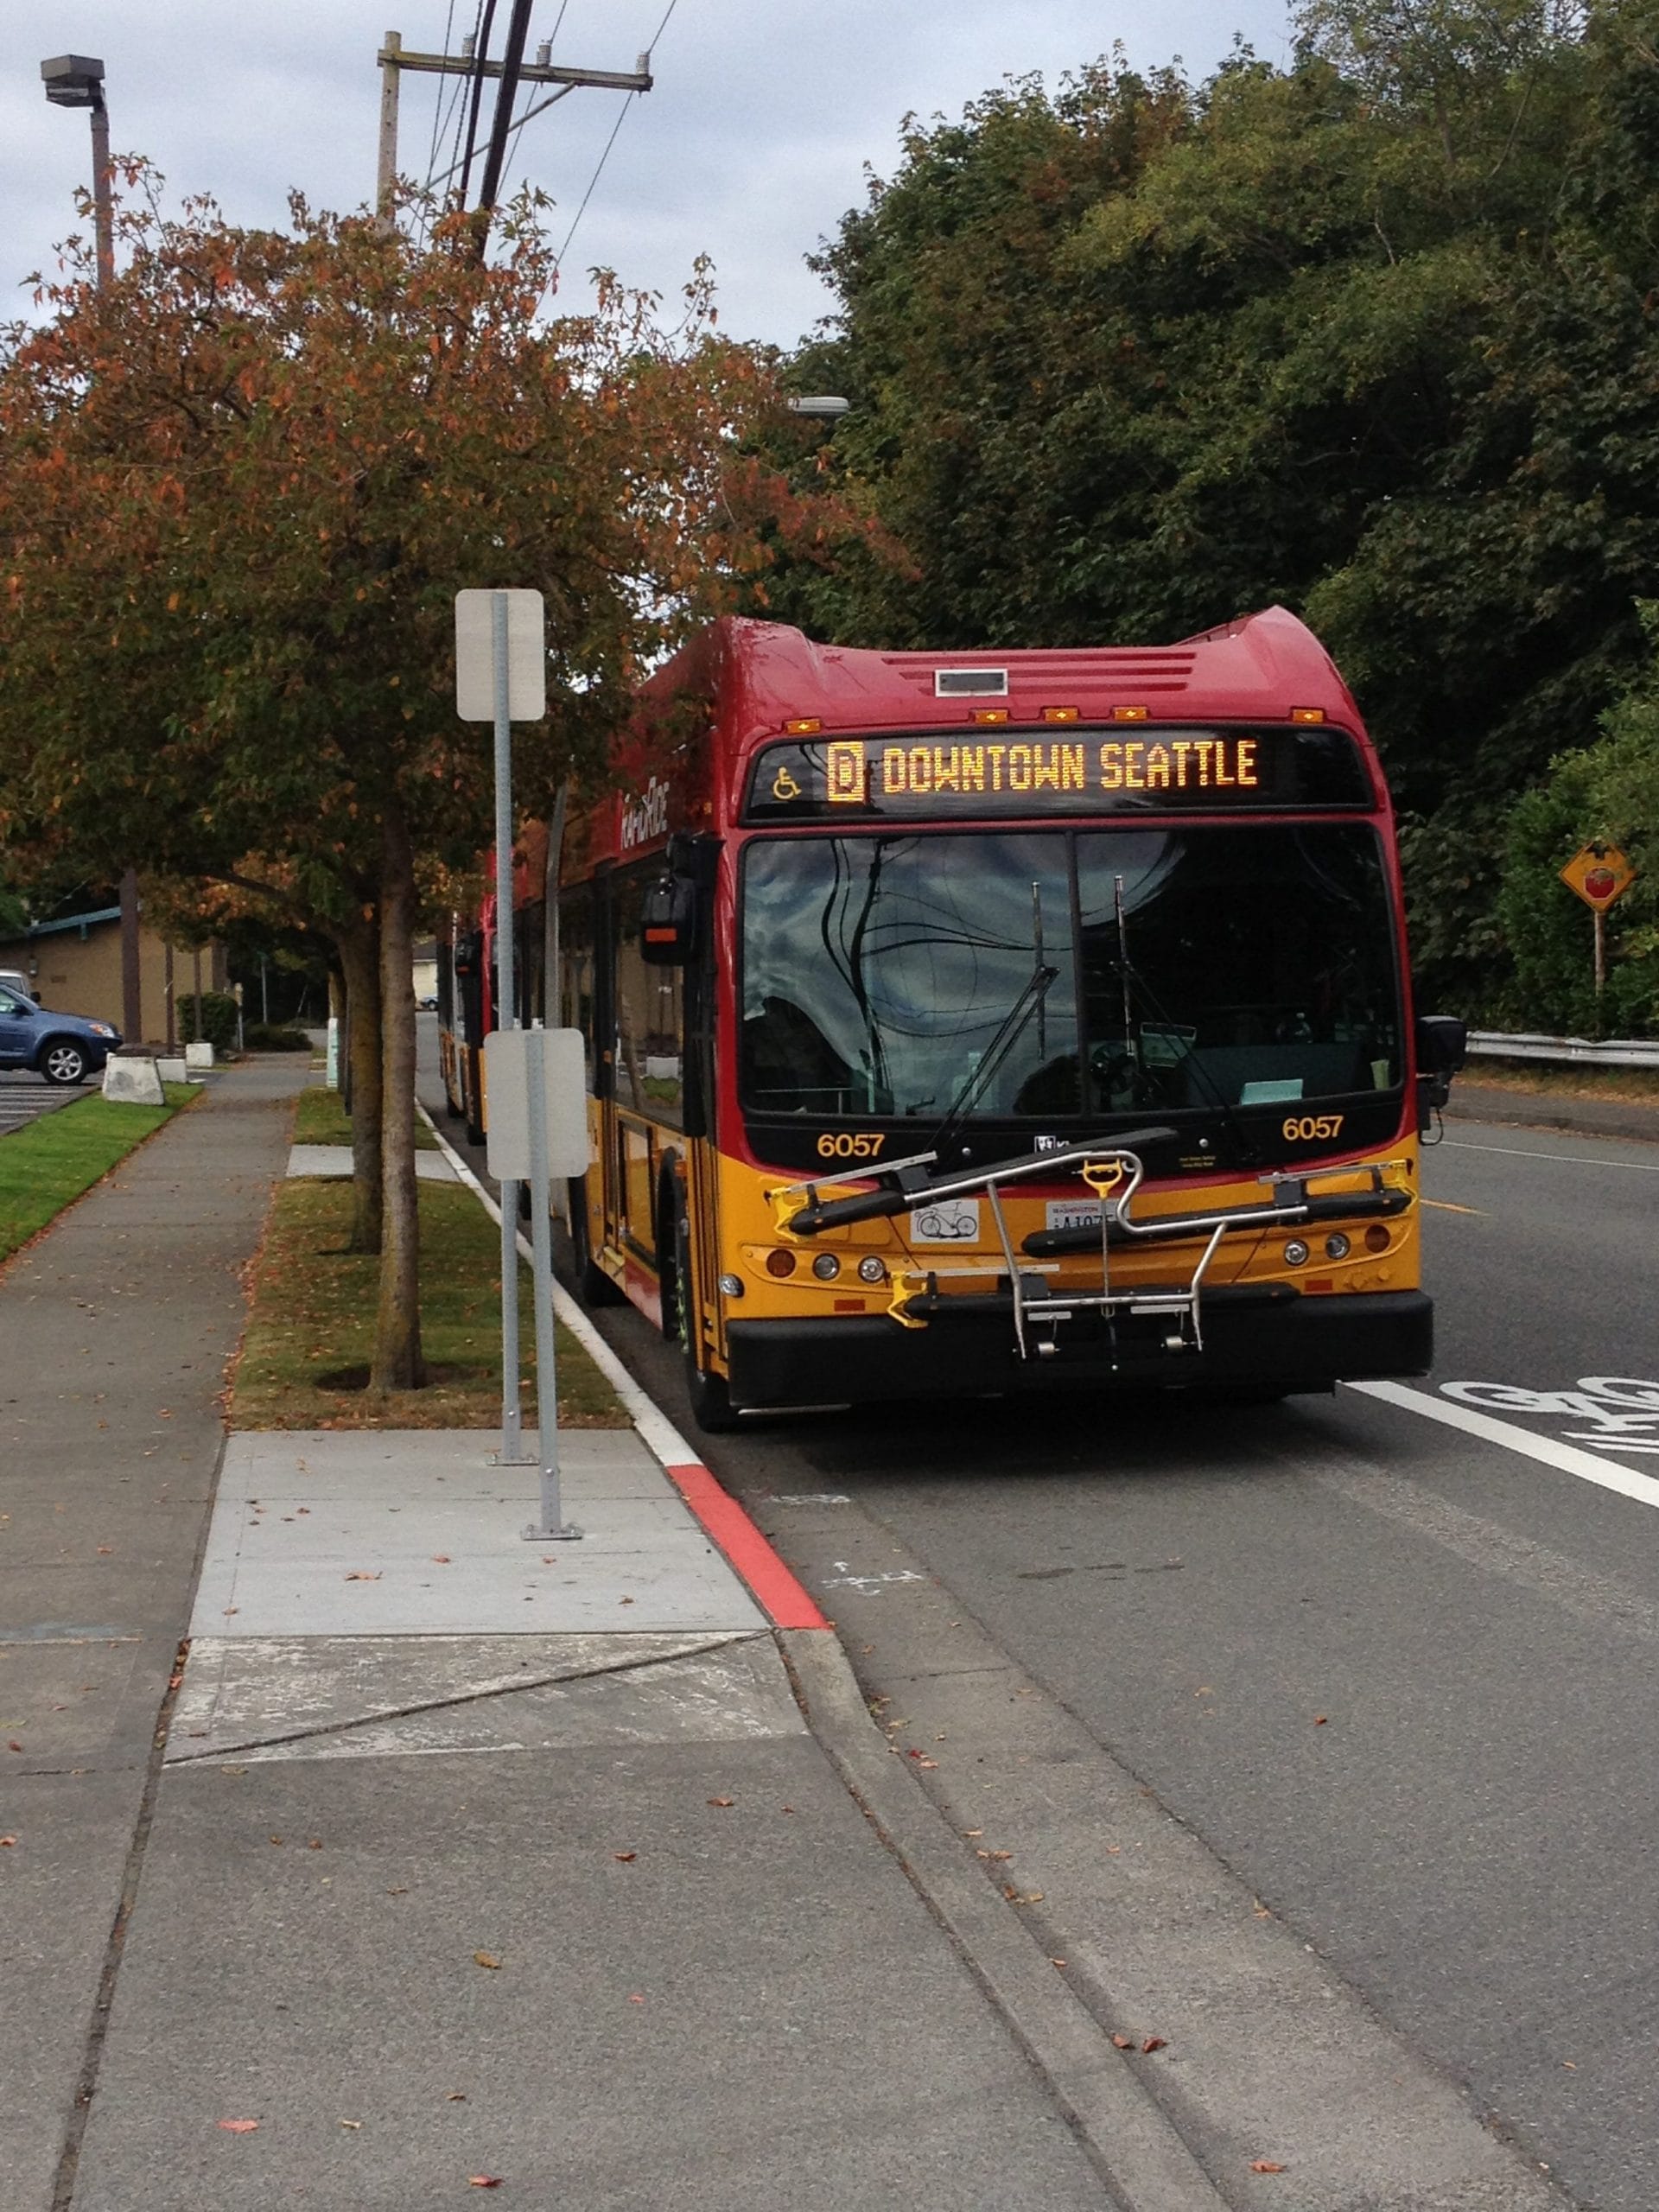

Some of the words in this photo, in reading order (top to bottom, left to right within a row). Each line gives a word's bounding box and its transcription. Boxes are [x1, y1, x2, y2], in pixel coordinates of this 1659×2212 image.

[883, 744, 1084, 793] DOWNTOWN
[1100, 741, 1258, 789] SEATTLE
[1282, 1115, 1344, 1141] 6057
[817, 1133, 886, 1157] 6057
